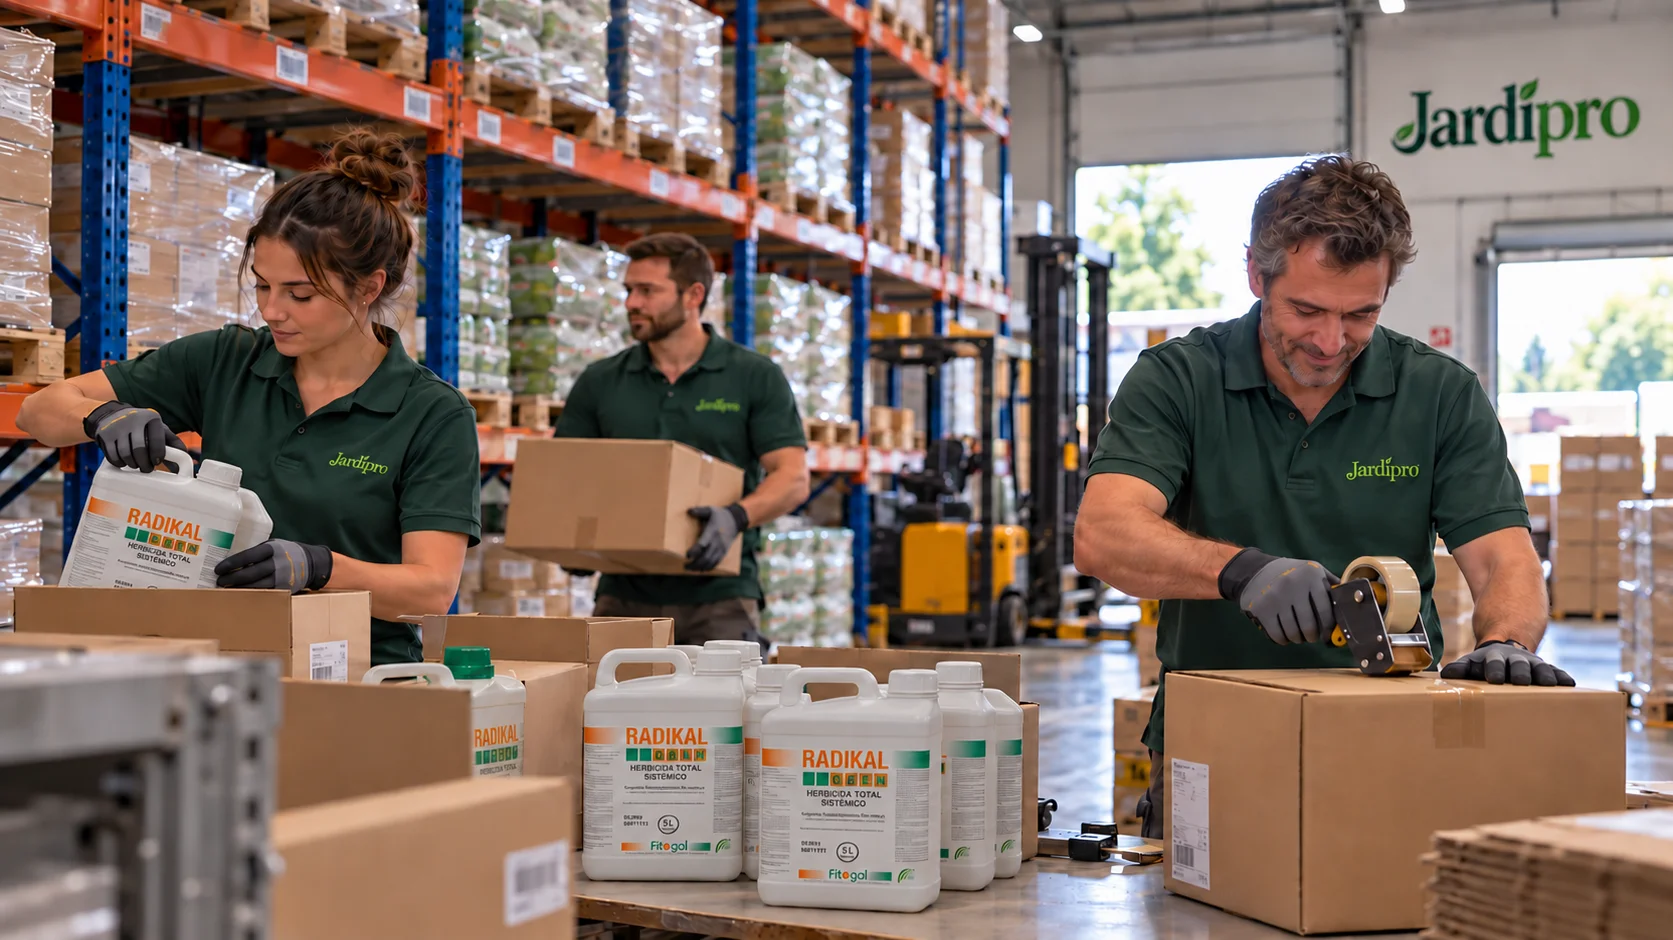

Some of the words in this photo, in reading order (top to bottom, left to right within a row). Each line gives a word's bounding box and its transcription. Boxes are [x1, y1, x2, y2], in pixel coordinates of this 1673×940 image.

[1391, 78, 1641, 159] Jardipro
[328, 451, 389, 475] Jardipro
[1345, 456, 1420, 482] Jardipro
[126, 507, 203, 543] RADIKAL
[473, 724, 519, 748] RADIKAL
[625, 727, 709, 746] RADIKAL
[675, 764, 702, 772] TOTAL
[802, 749, 889, 770] RADIKAL
[854, 790, 882, 799] TOTAL
[650, 839, 688, 854] Fitogol
[828, 868, 868, 883] Fitogol
